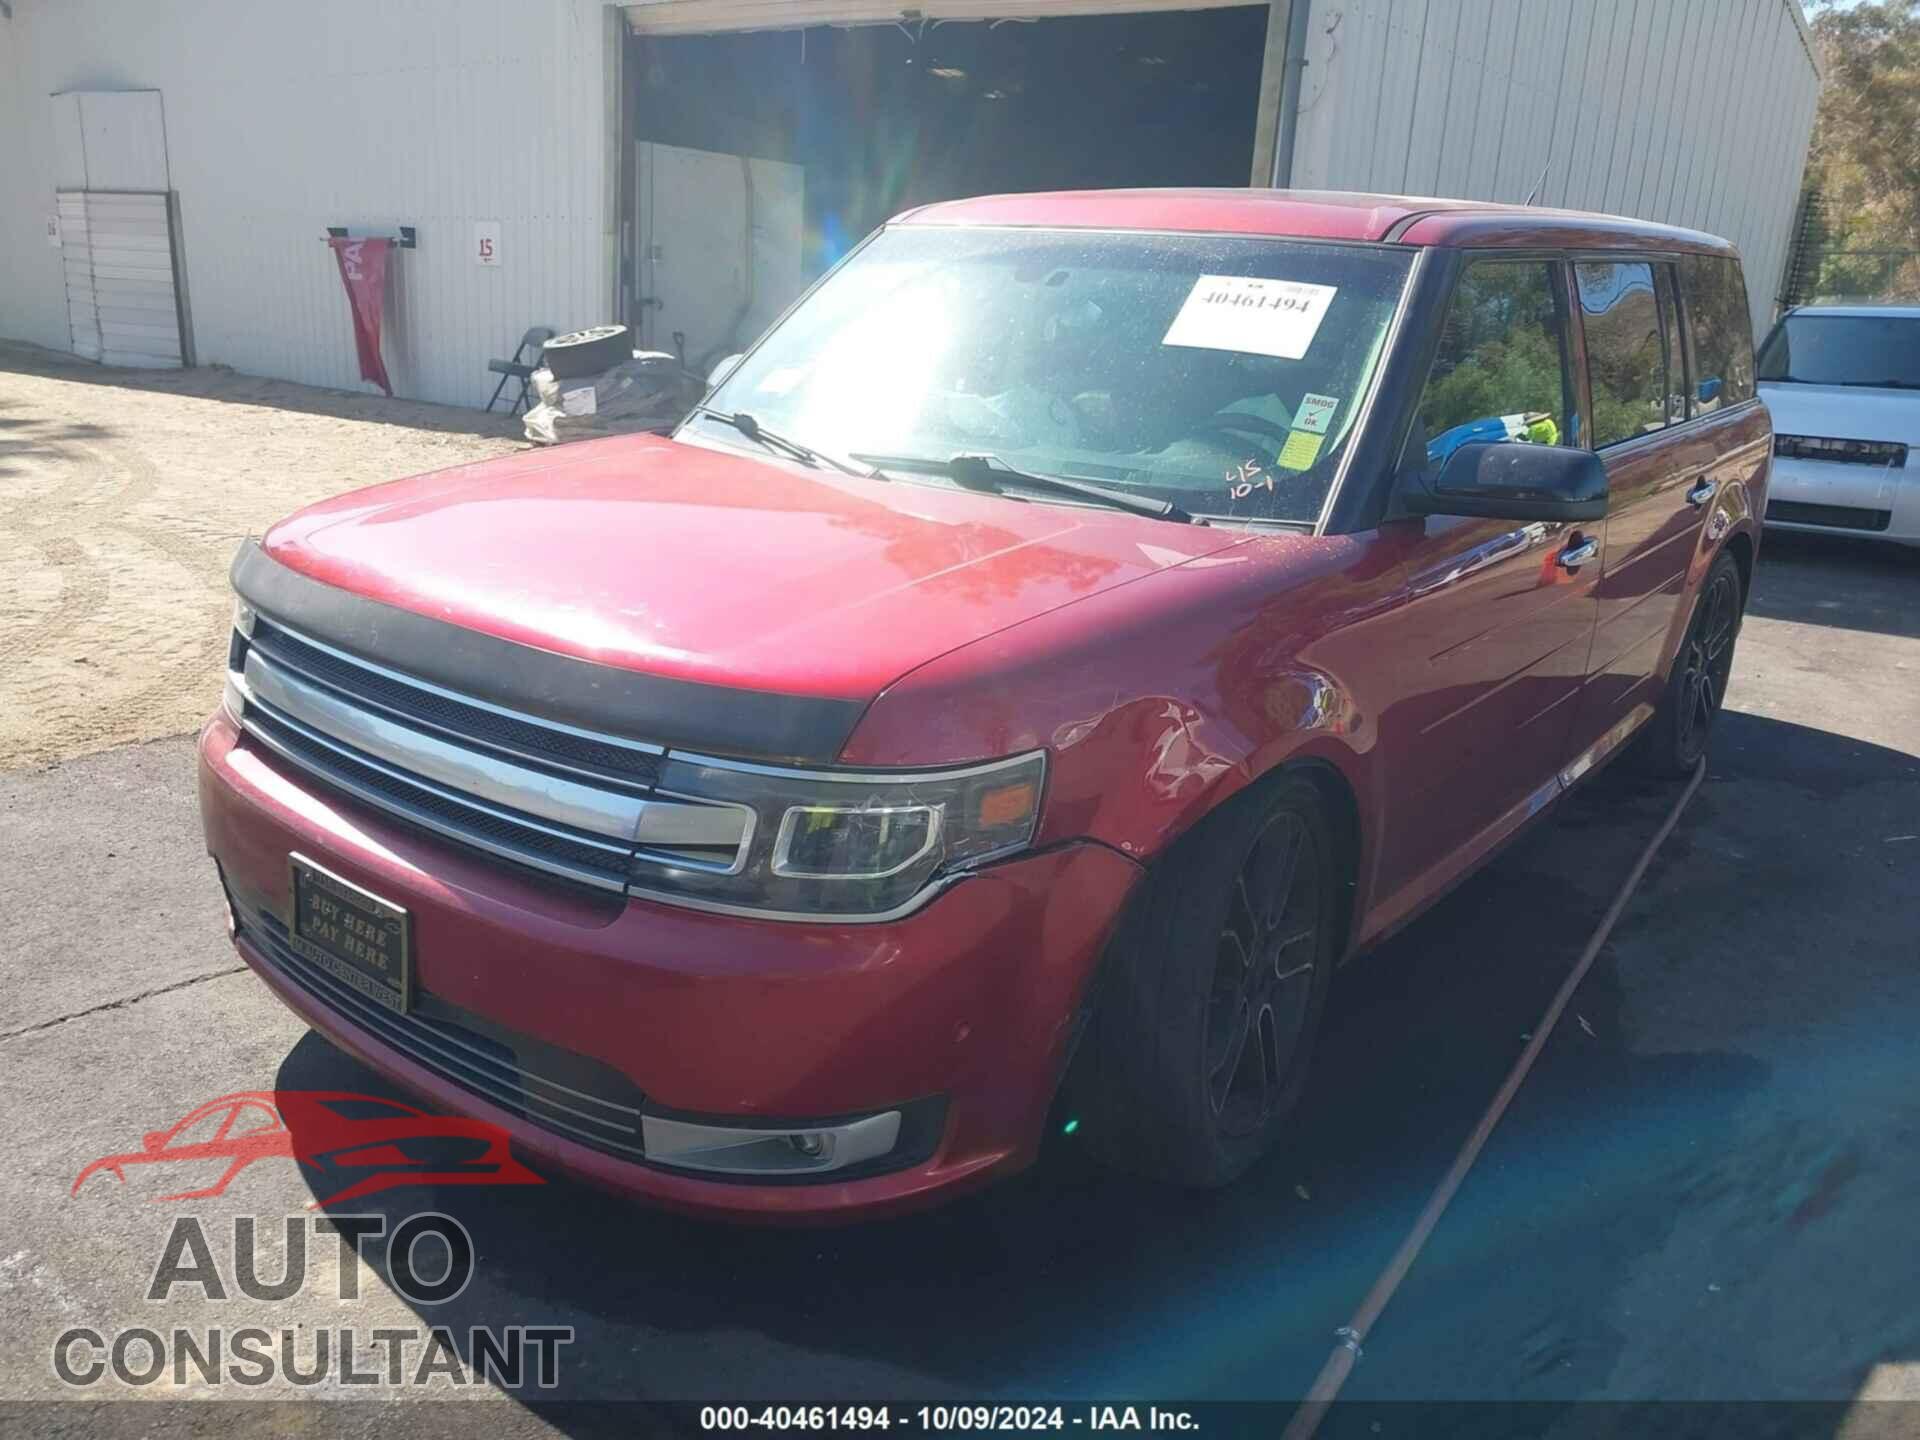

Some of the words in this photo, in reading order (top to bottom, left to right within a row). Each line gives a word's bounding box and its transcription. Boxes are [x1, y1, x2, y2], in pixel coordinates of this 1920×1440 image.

[479, 238, 493, 257] 15
[1202, 291, 1311, 313] 40461494
[1305, 397, 1335, 409] SMOG
[1304, 417, 1317, 425] OK
[312, 894, 337, 921] BUY
[343, 912, 387, 947] HERE
[313, 915, 338, 941] PAY
[344, 932, 388, 970] HERE
